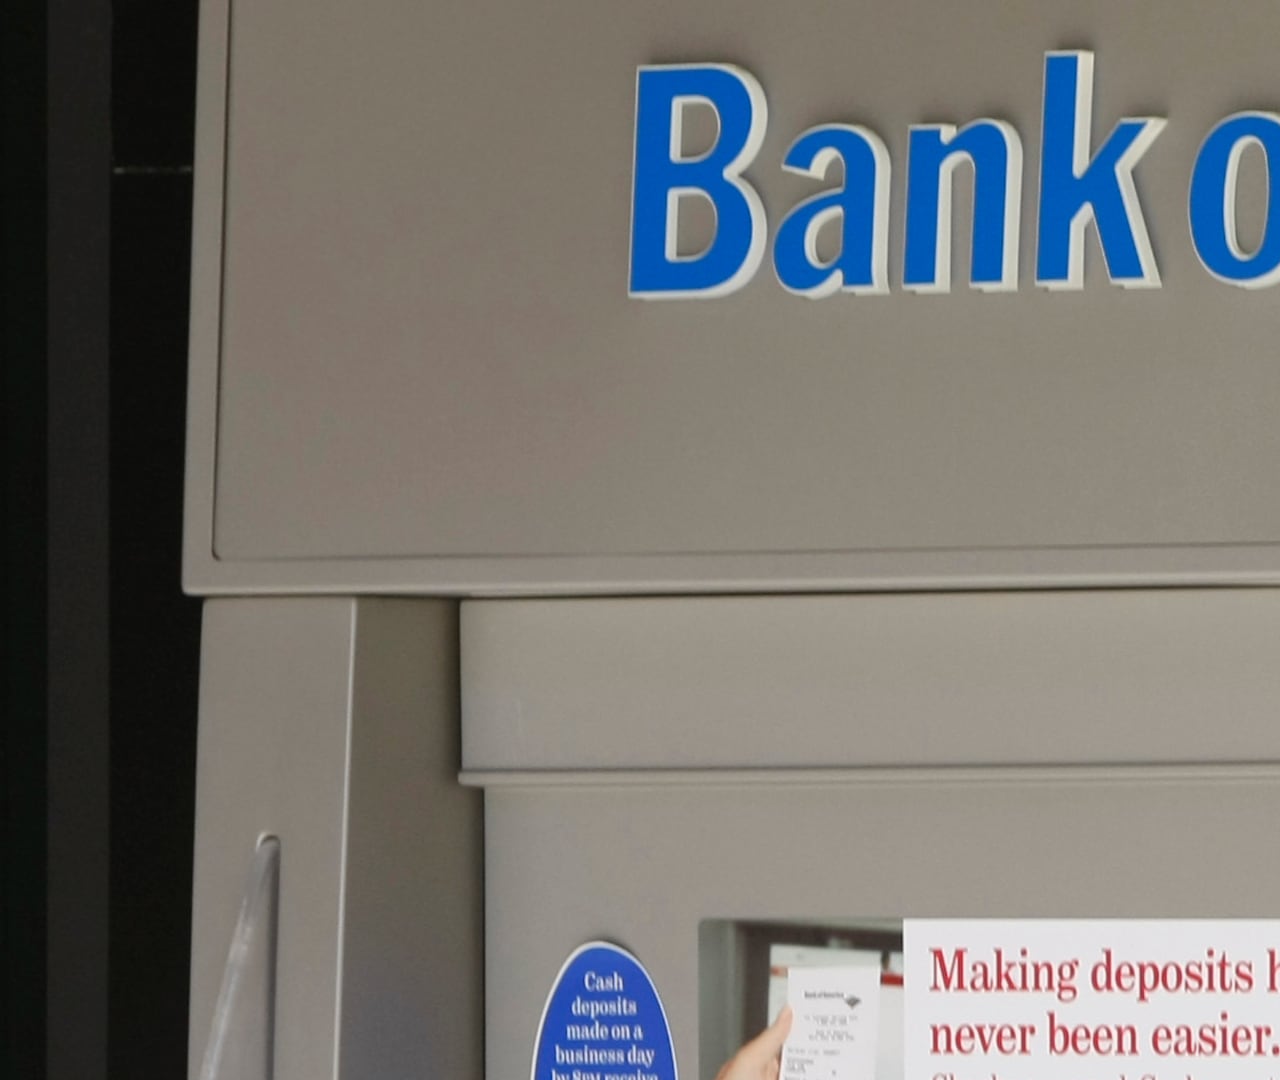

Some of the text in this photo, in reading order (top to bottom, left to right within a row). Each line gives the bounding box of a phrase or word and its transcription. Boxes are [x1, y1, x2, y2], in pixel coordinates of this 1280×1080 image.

[628, 49, 1167, 300] Bank
[584, 971, 624, 991] Cash
[929, 948, 1079, 1002] Making
[1090, 948, 1254, 1002] deposits
[571, 996, 637, 1019] deposits
[566, 1021, 643, 1040] made on a
[930, 1012, 1280, 1056] never been easier.
[555, 1044, 655, 1068] business day
